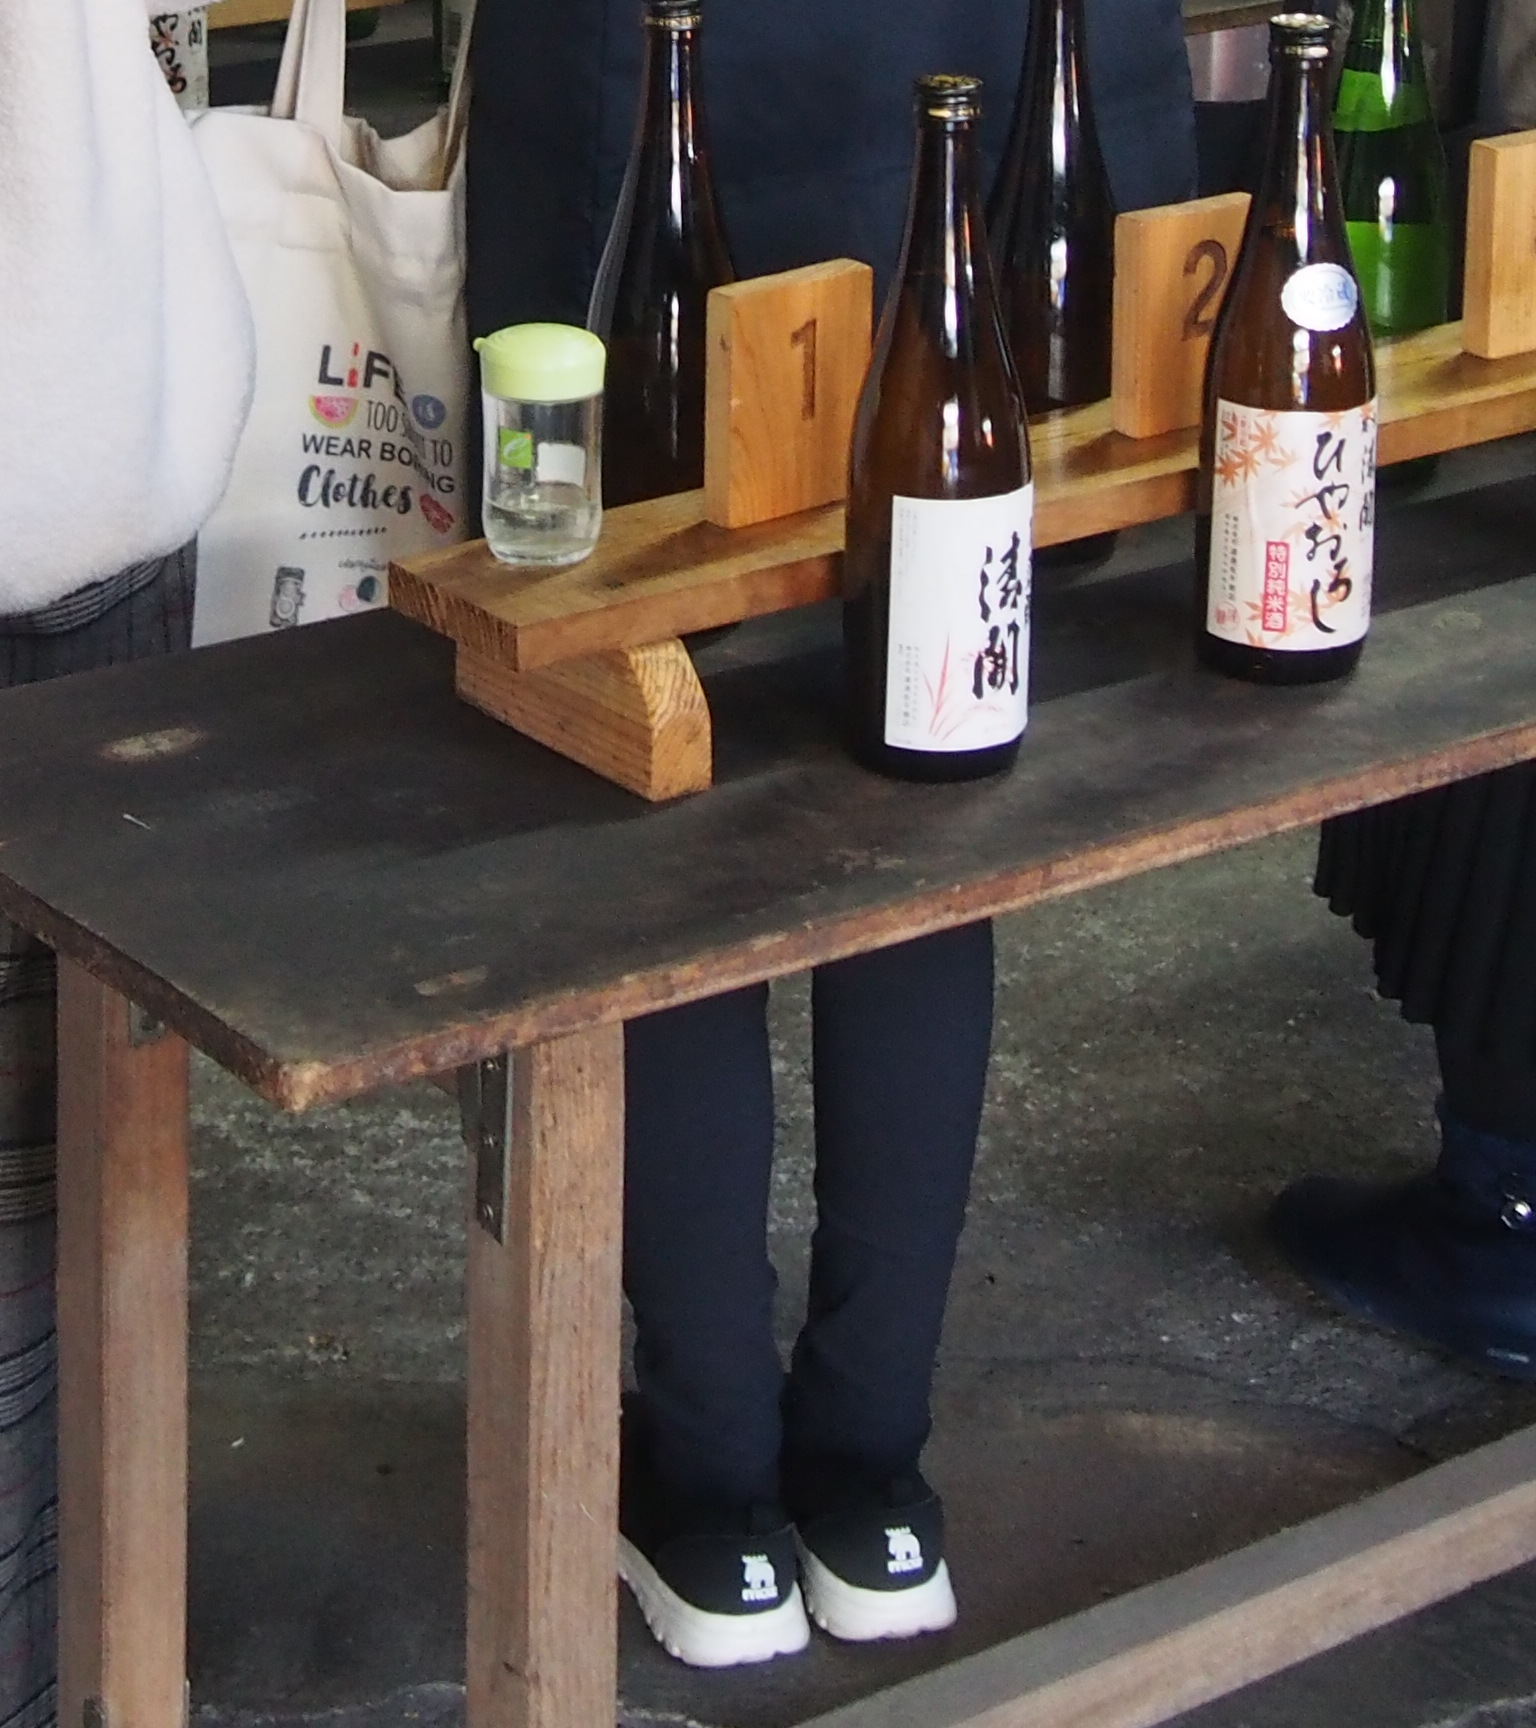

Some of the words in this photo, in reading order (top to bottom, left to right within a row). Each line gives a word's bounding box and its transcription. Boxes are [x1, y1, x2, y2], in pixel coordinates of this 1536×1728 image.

[1181, 239, 1229, 343] 2
[790, 318, 818, 421] 1
[302, 432, 372, 460] WEAR
[366, 399, 398, 433] TOO
[297, 463, 413, 515] Clothes
[1296, 430, 1353, 633] ひやおろし
[1264, 544, 1287, 630] 特別純米酒
